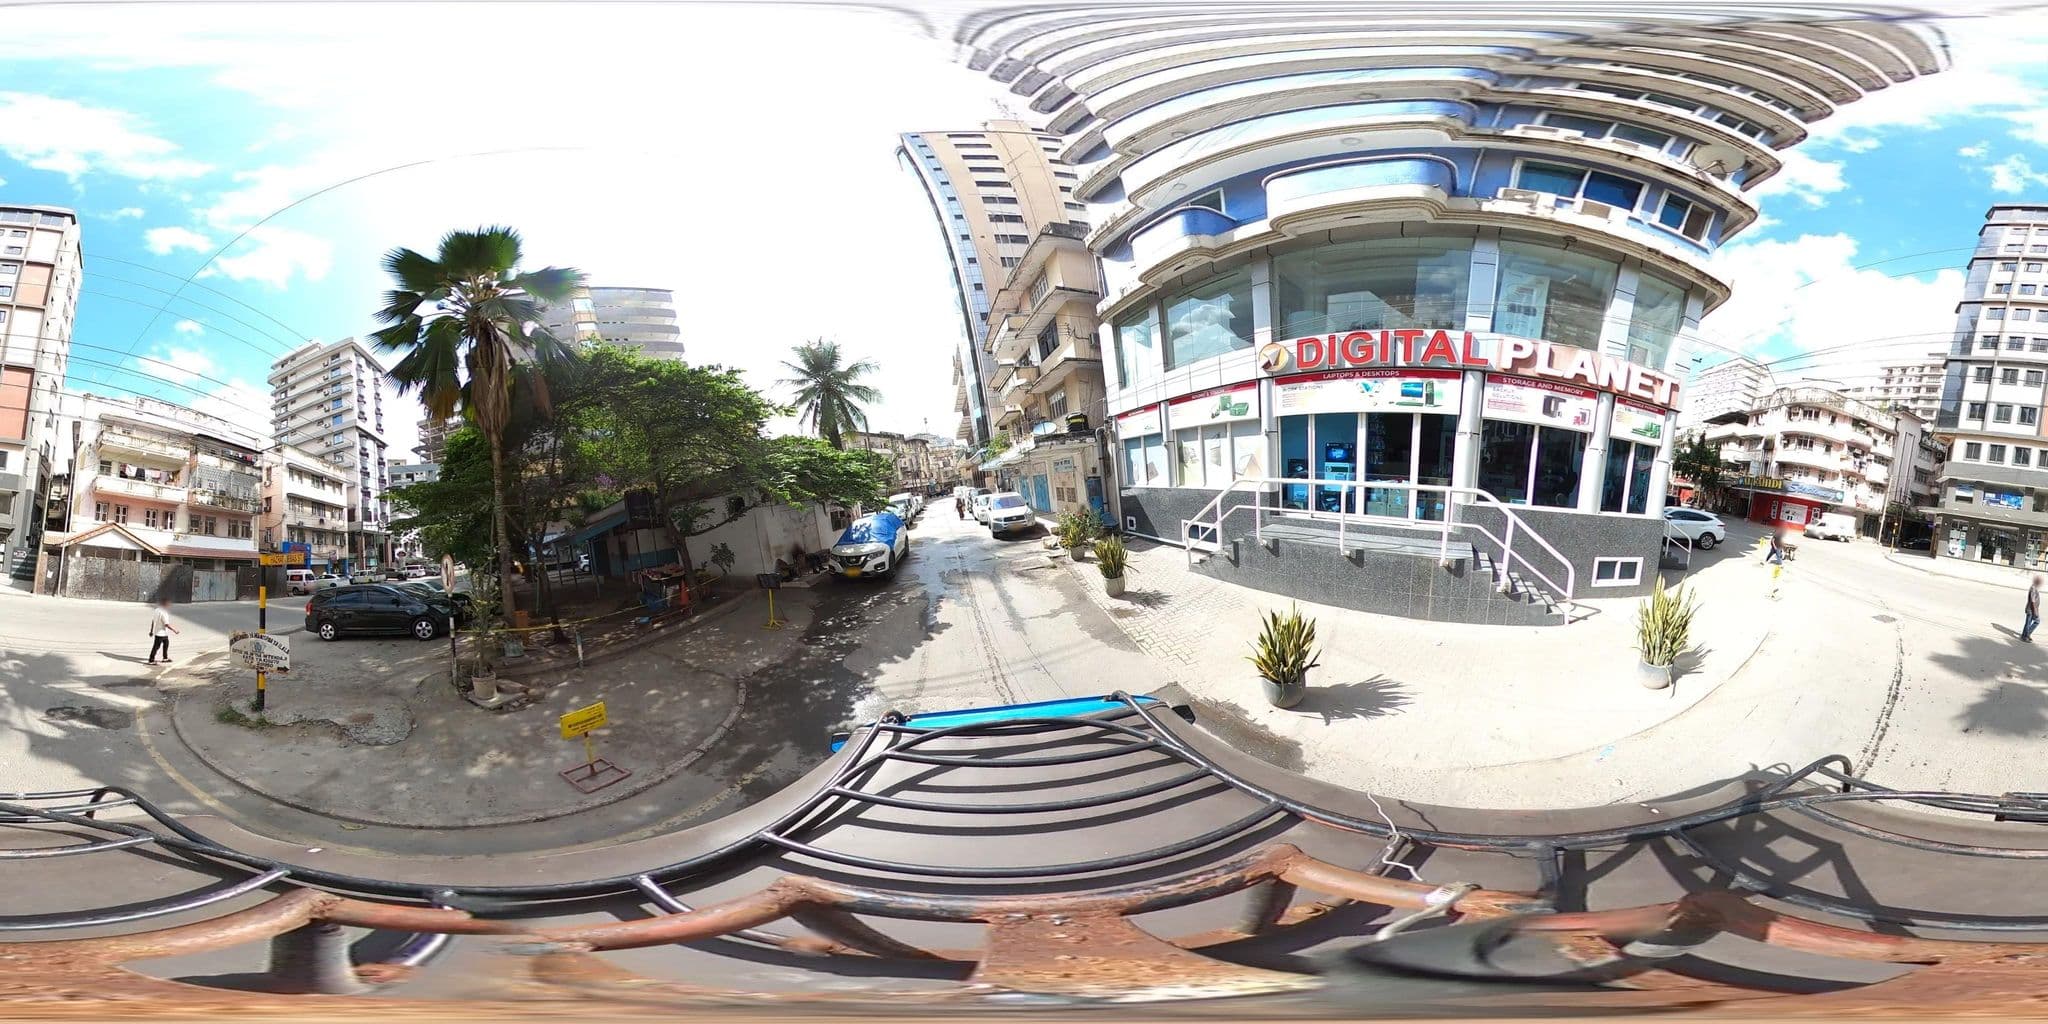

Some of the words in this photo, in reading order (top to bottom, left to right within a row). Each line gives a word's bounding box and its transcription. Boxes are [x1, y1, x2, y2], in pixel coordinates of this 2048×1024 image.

[1296, 329, 1489, 369] DIGITAL
[1503, 338, 1680, 404] PLANET
[1502, 377, 1536, 387] STORAGE
[1554, 385, 1585, 395] MEMORY
